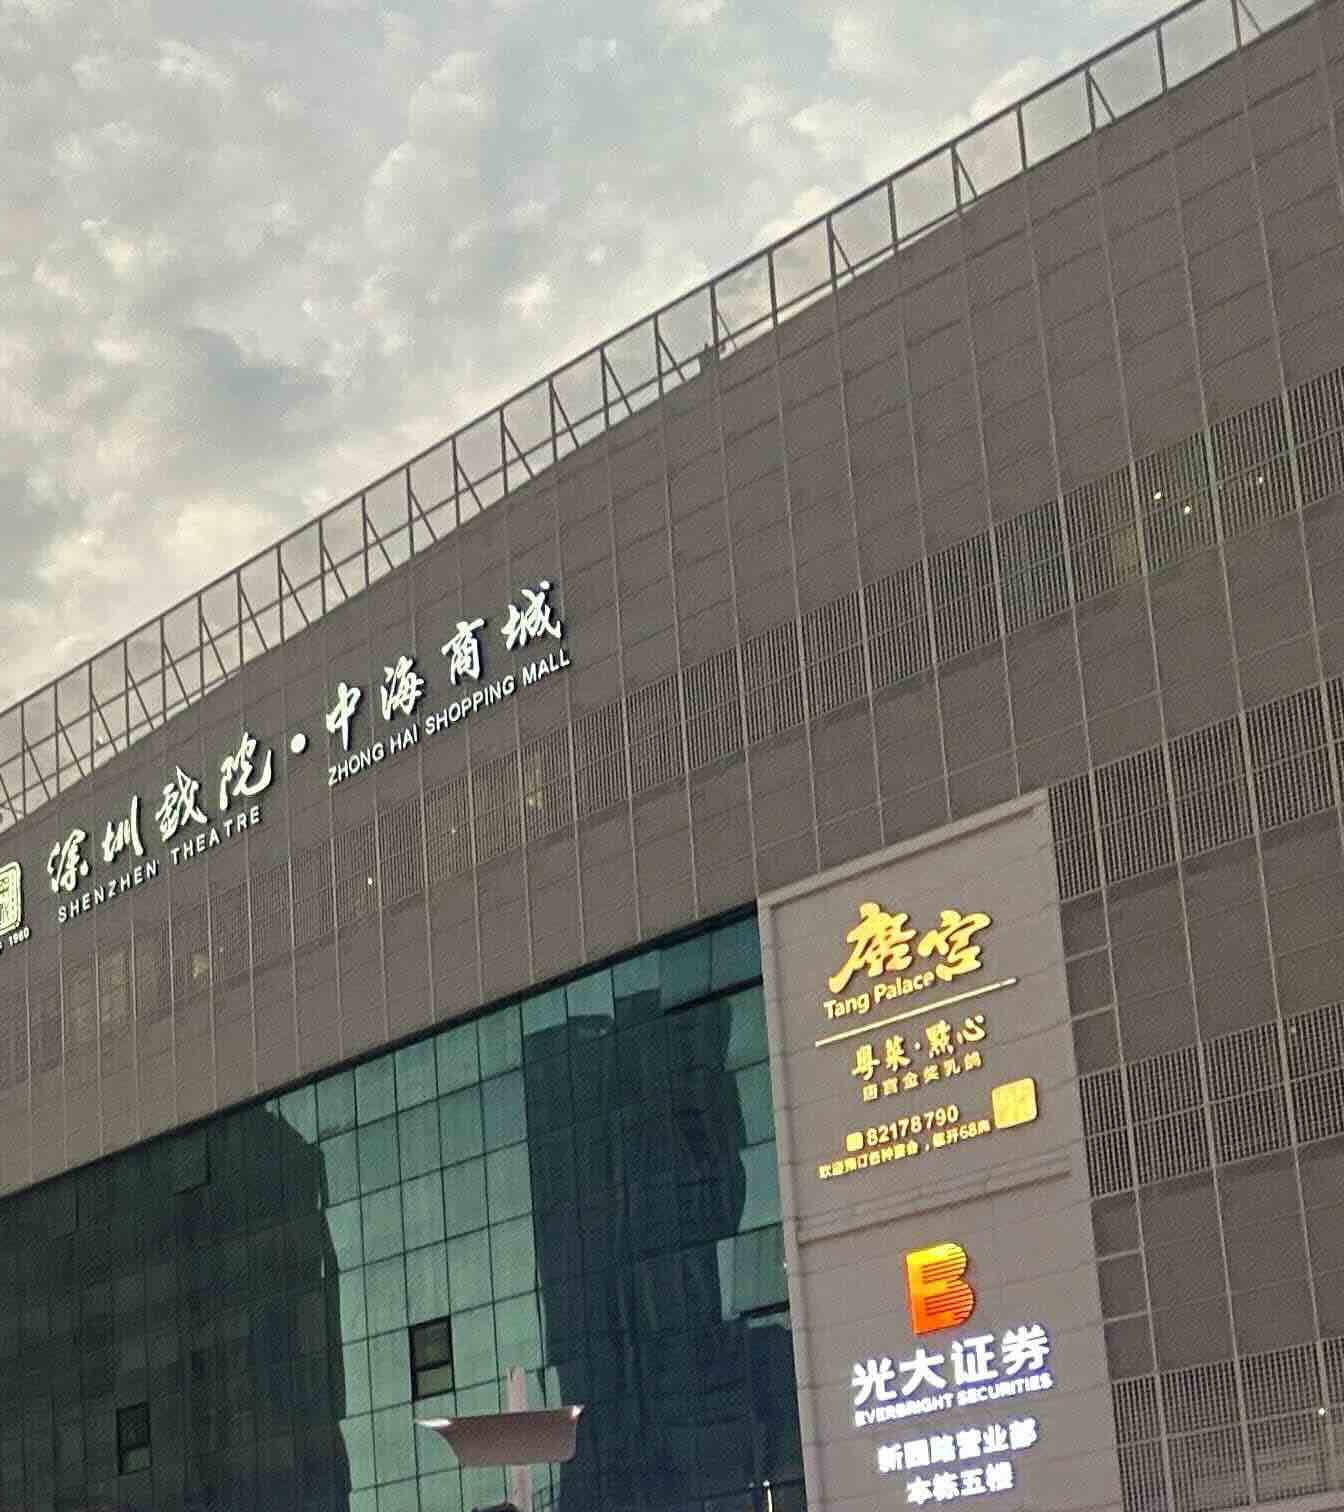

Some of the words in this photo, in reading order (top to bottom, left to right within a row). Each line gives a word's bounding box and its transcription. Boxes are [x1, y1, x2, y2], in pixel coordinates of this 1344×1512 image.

[328, 743, 385, 787] ZHONG
[390, 724, 418, 754] HAI
[424, 675, 516, 735] SHOPPING
[522, 648, 571, 686] MALL
[57, 859, 159, 923] SHENZHEN
[170, 805, 261, 865] THEATRE
[823, 992, 871, 1020] Tang
[873, 968, 936, 1004] Palace
[865, 1104, 960, 1146] 82178790
[850, 1323, 1051, 1406] 光大证券
